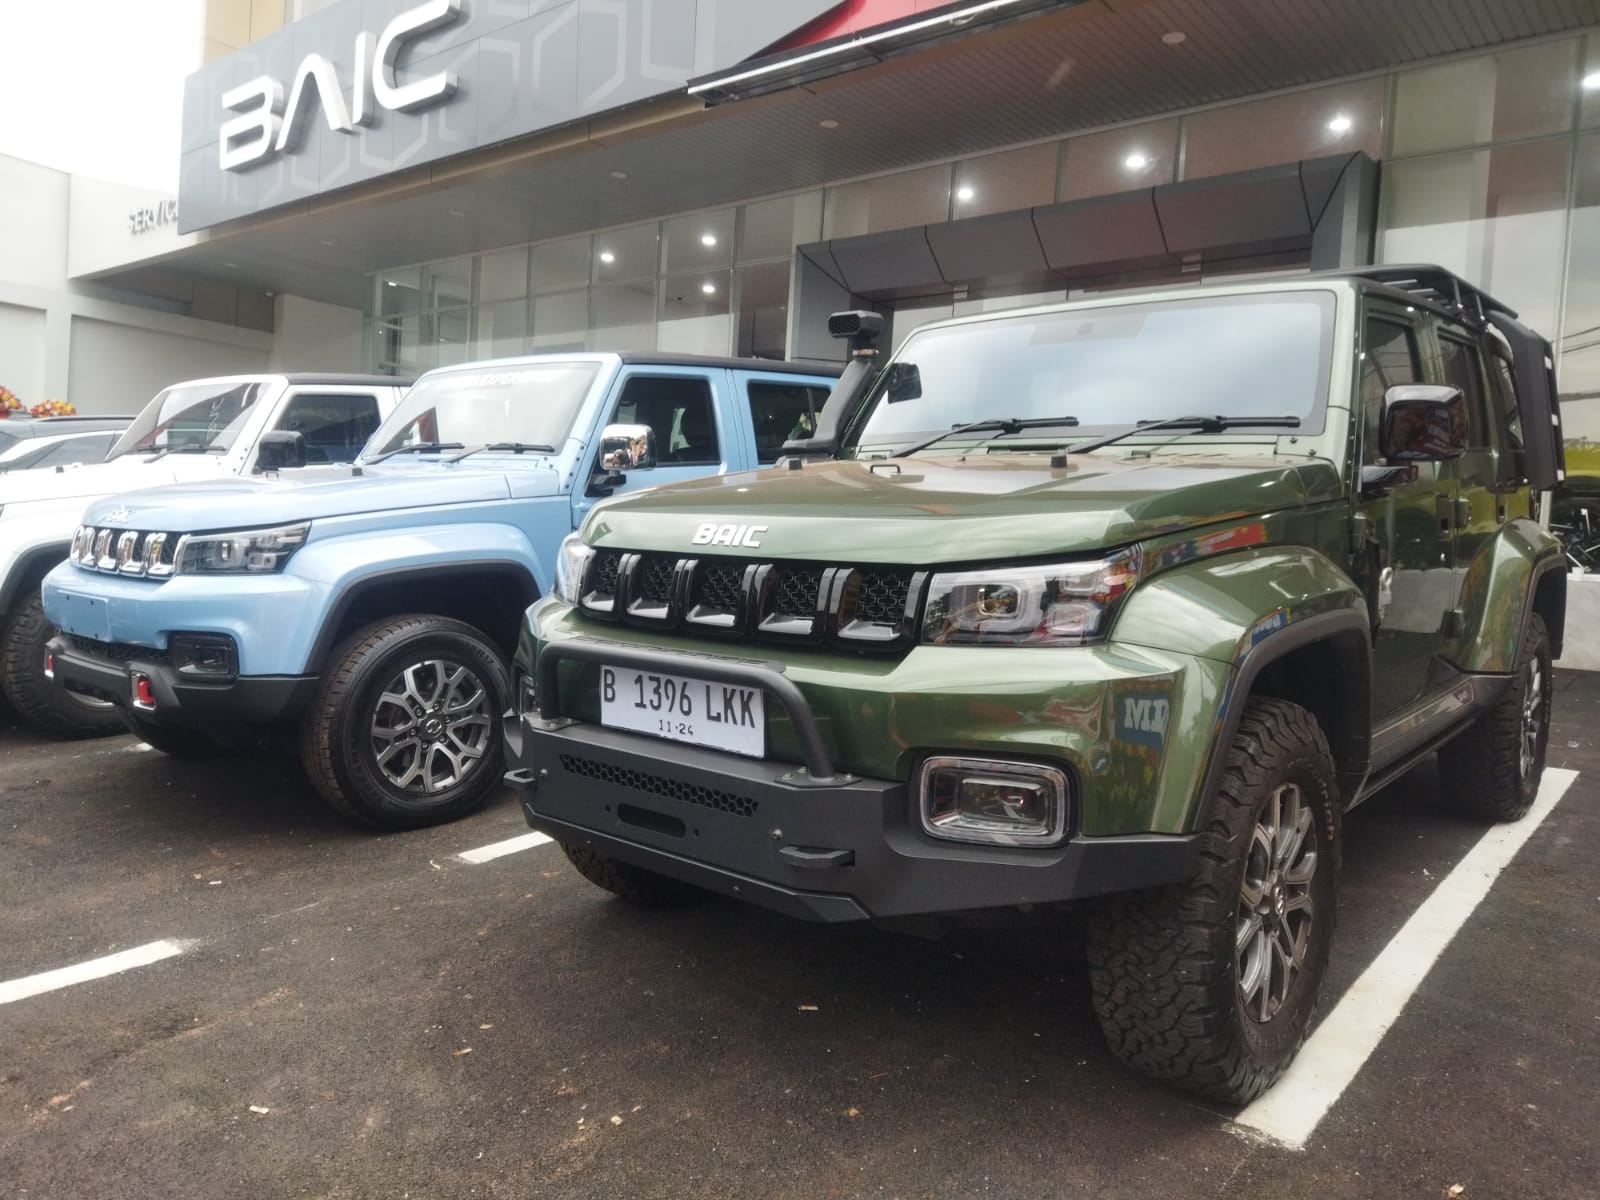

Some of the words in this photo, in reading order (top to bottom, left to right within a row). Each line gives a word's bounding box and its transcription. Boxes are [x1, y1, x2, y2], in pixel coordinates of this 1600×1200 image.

[220, 0, 459, 172] BAIC
[692, 523, 768, 547] BAIC
[603, 669, 616, 703] B
[634, 674, 693, 716] 1396
[706, 684, 757, 729] LKK
